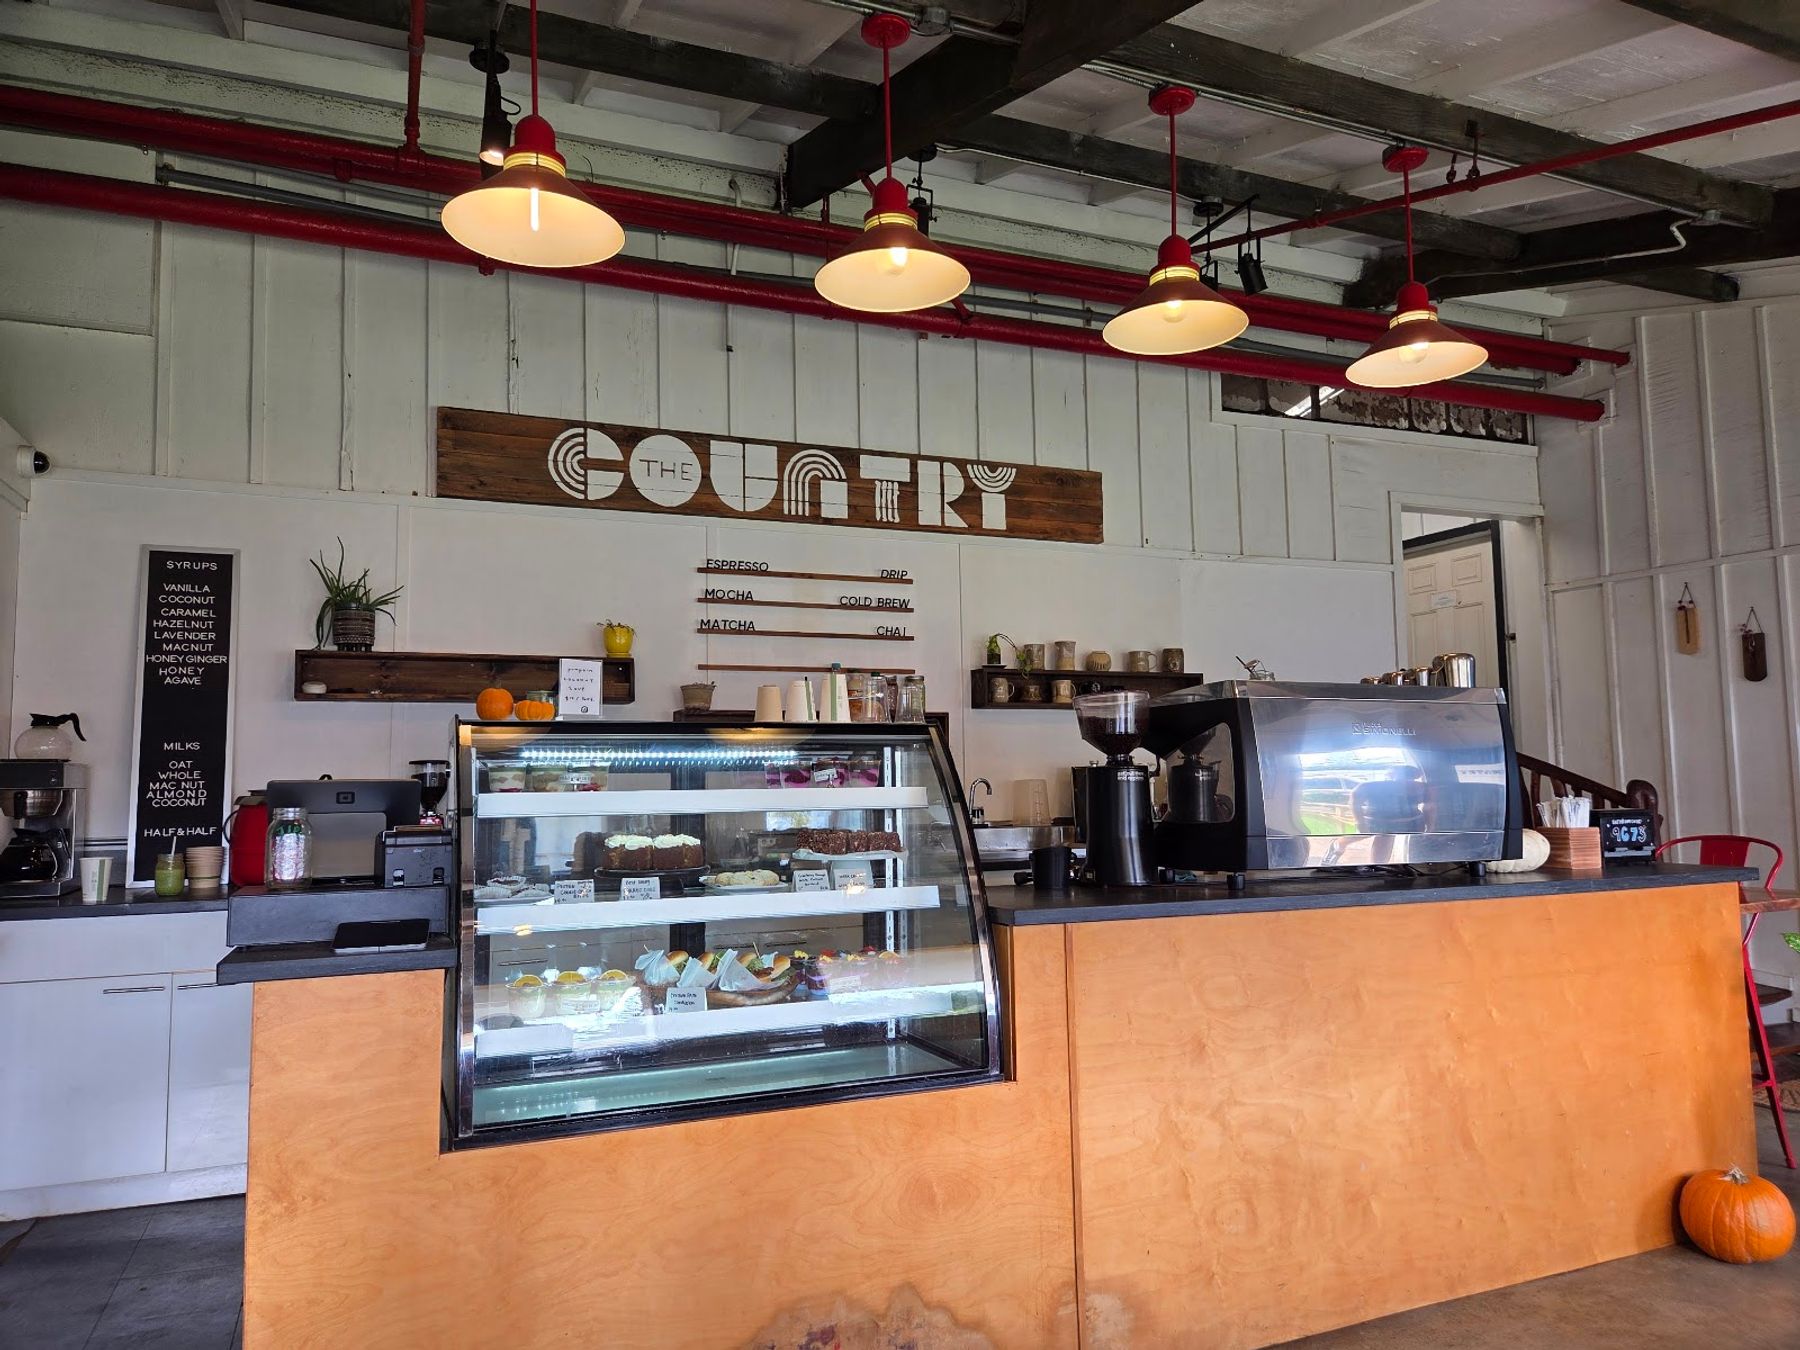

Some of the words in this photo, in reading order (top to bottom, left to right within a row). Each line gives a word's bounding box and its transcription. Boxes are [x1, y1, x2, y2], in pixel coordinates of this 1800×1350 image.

[639, 458, 693, 482] THE
[547, 427, 1017, 530] COUNTRY
[166, 560, 218, 571] SYRUPS
[706, 559, 769, 571] ESPRESSO
[880, 569, 908, 579] DRIP
[163, 583, 211, 593] VANILLA
[159, 595, 216, 604] COCONUT
[704, 588, 754, 601] MOCHA
[839, 596, 872, 607] COLD
[877, 597, 910, 608] BREW
[160, 608, 217, 617] CARAMEL
[153, 620, 215, 629] HAZELNUT
[699, 618, 756, 631] MATCHA
[154, 631, 216, 640] LAVENDER
[876, 625, 907, 637] CHAI
[146, 655, 184, 663] HONEY
[185, 655, 228, 663] GINGER
[159, 666, 205, 676] HONEY
[164, 676, 202, 685] AGAVE
[163, 742, 201, 751] MILKS
[168, 760, 193, 769] OAT
[158, 771, 202, 780] WHOLE
[149, 781, 177, 790] MAC
[181, 780, 205, 789] NUT
[146, 790, 207, 799] ALMOND
[152, 798, 207, 807] COCONUT
